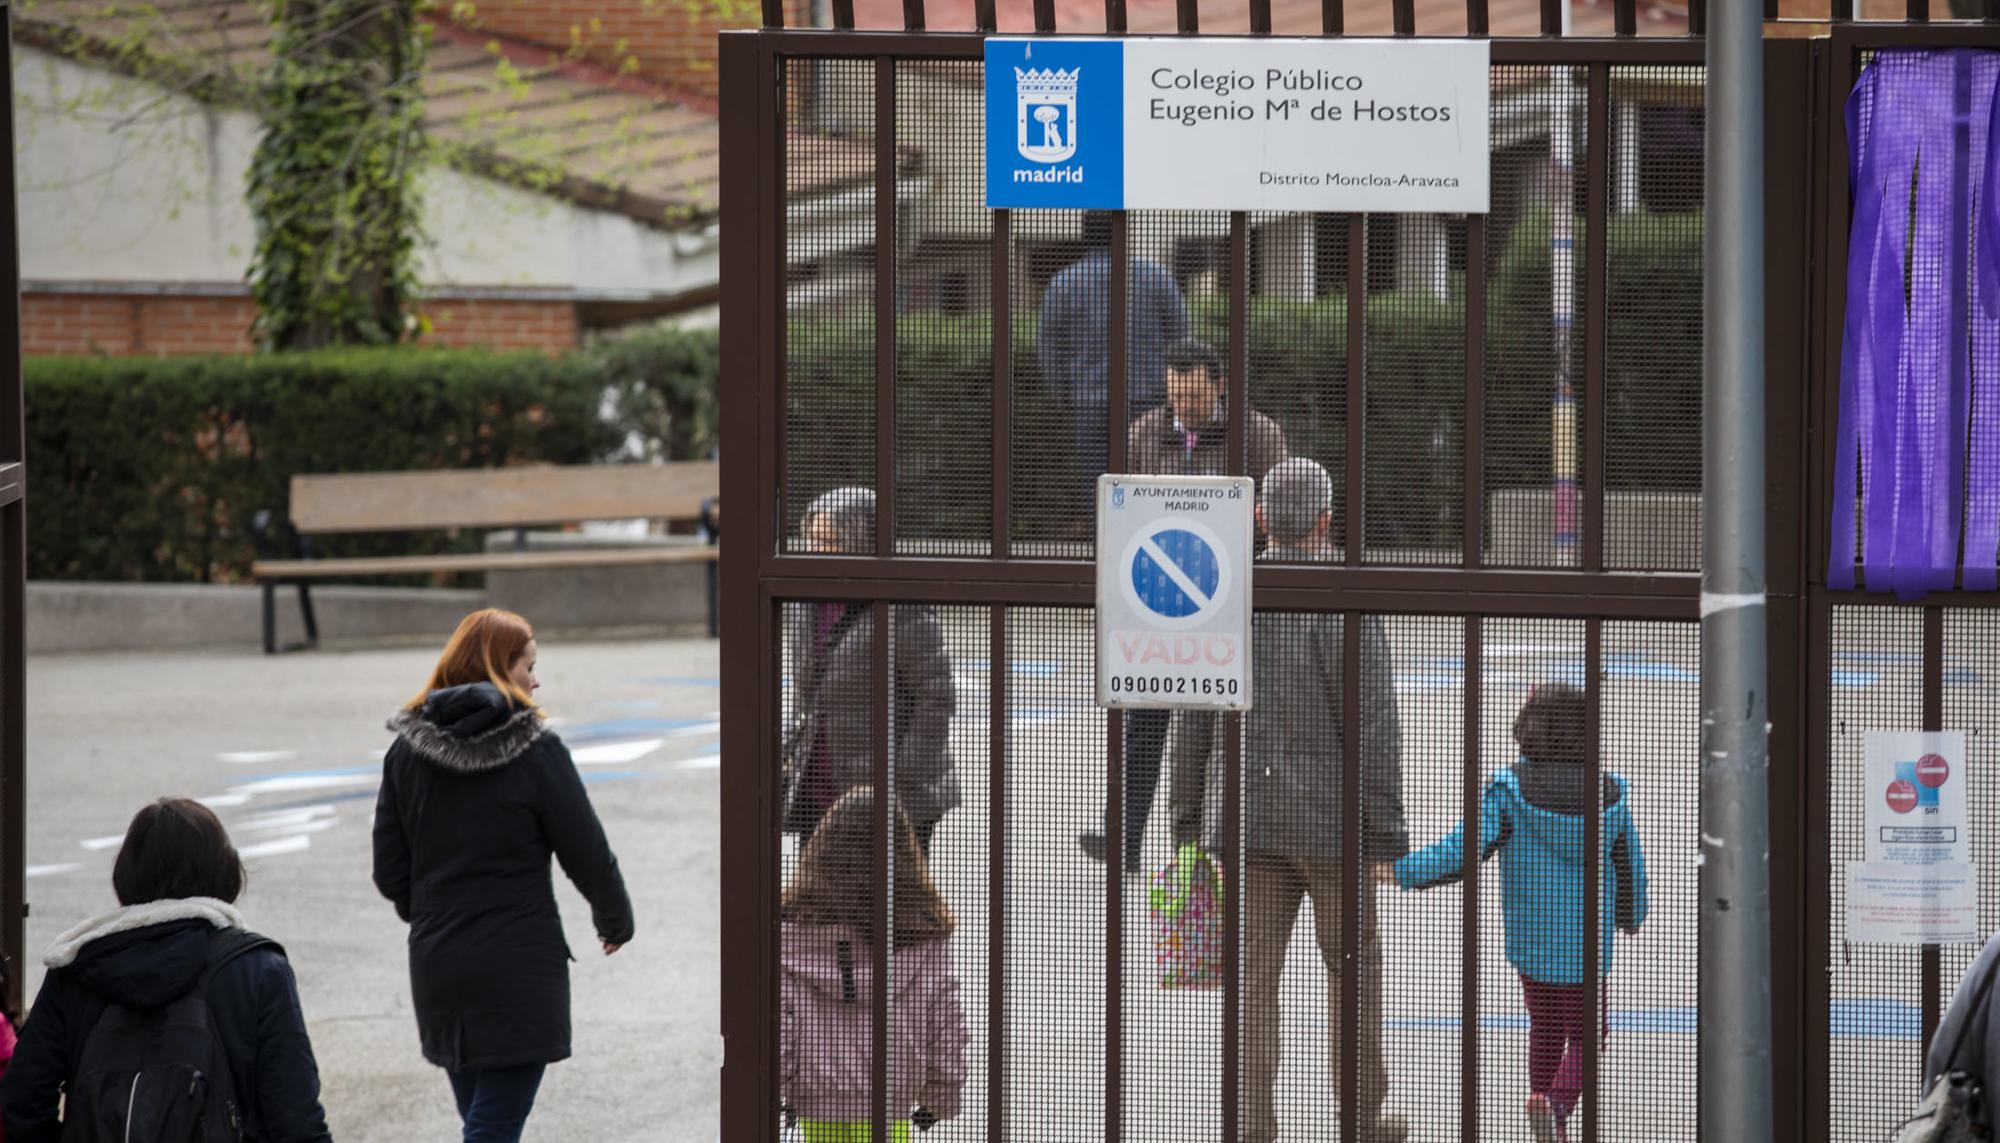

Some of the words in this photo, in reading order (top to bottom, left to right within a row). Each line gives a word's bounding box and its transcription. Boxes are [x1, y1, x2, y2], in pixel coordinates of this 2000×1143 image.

[1151, 68, 1254, 96] Colegio
[1266, 68, 1363, 91] Público
[1149, 99, 1254, 126] Eugenio
[1310, 99, 1342, 121] de
[1353, 100, 1451, 122] Hostos
[1013, 166, 1083, 184] madrid
[1259, 171, 1320, 187] Distrito
[1326, 172, 1460, 188] Moncloa-Aravaca
[1133, 488, 1224, 499] AYUNTAMIENTO
[1228, 489, 1242, 499] DE
[1165, 501, 1210, 511] MADRID
[1115, 631, 1237, 667] VADO
[1111, 676, 1238, 695] 0900021650
